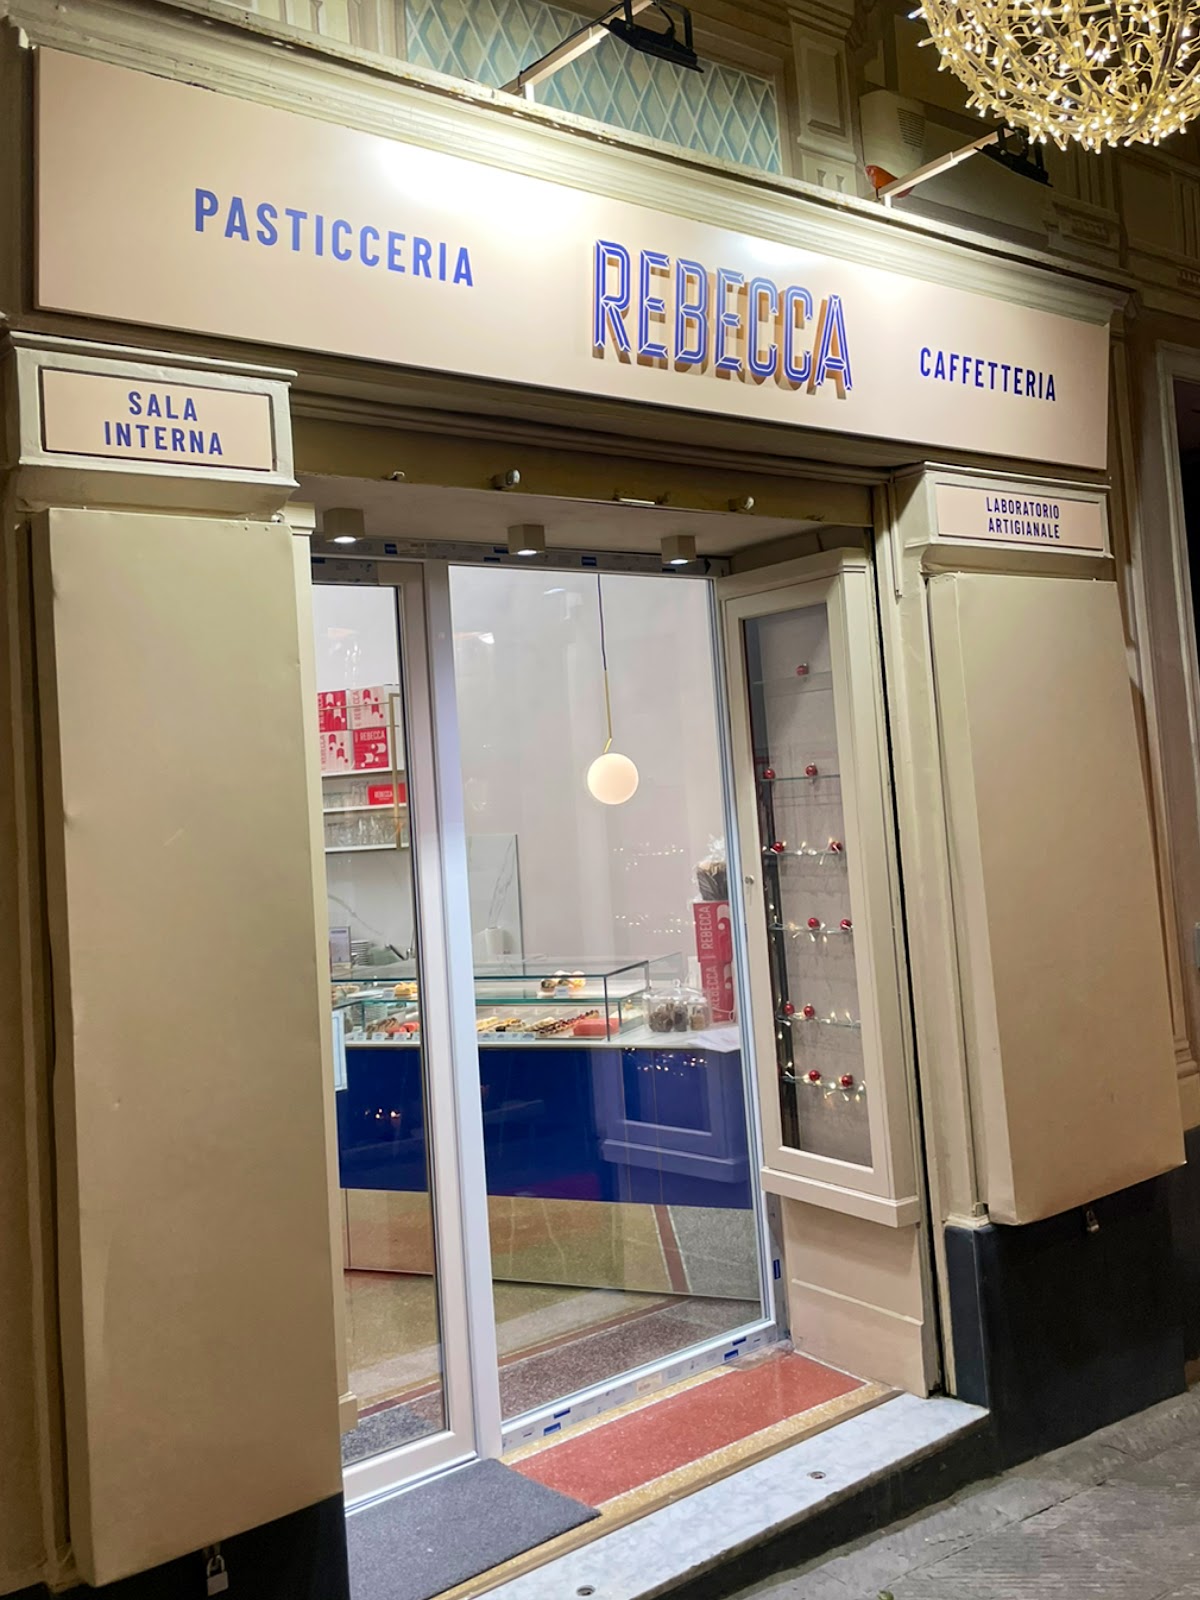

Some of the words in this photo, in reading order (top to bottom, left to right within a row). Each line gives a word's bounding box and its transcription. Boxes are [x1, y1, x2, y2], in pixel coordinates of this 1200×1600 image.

[195, 188, 474, 287] PASTICCERIA
[595, 239, 853, 391] REBECCA
[920, 347, 1056, 401] CAFFETTERIA
[128, 391, 198, 422] SALA
[104, 421, 223, 455] INTERNA
[986, 497, 1060, 519] LABORATORIO
[988, 518, 1060, 539] ARTIGIANALE
[360, 731, 386, 742] REBECCA
[699, 906, 714, 950] REBECCA
